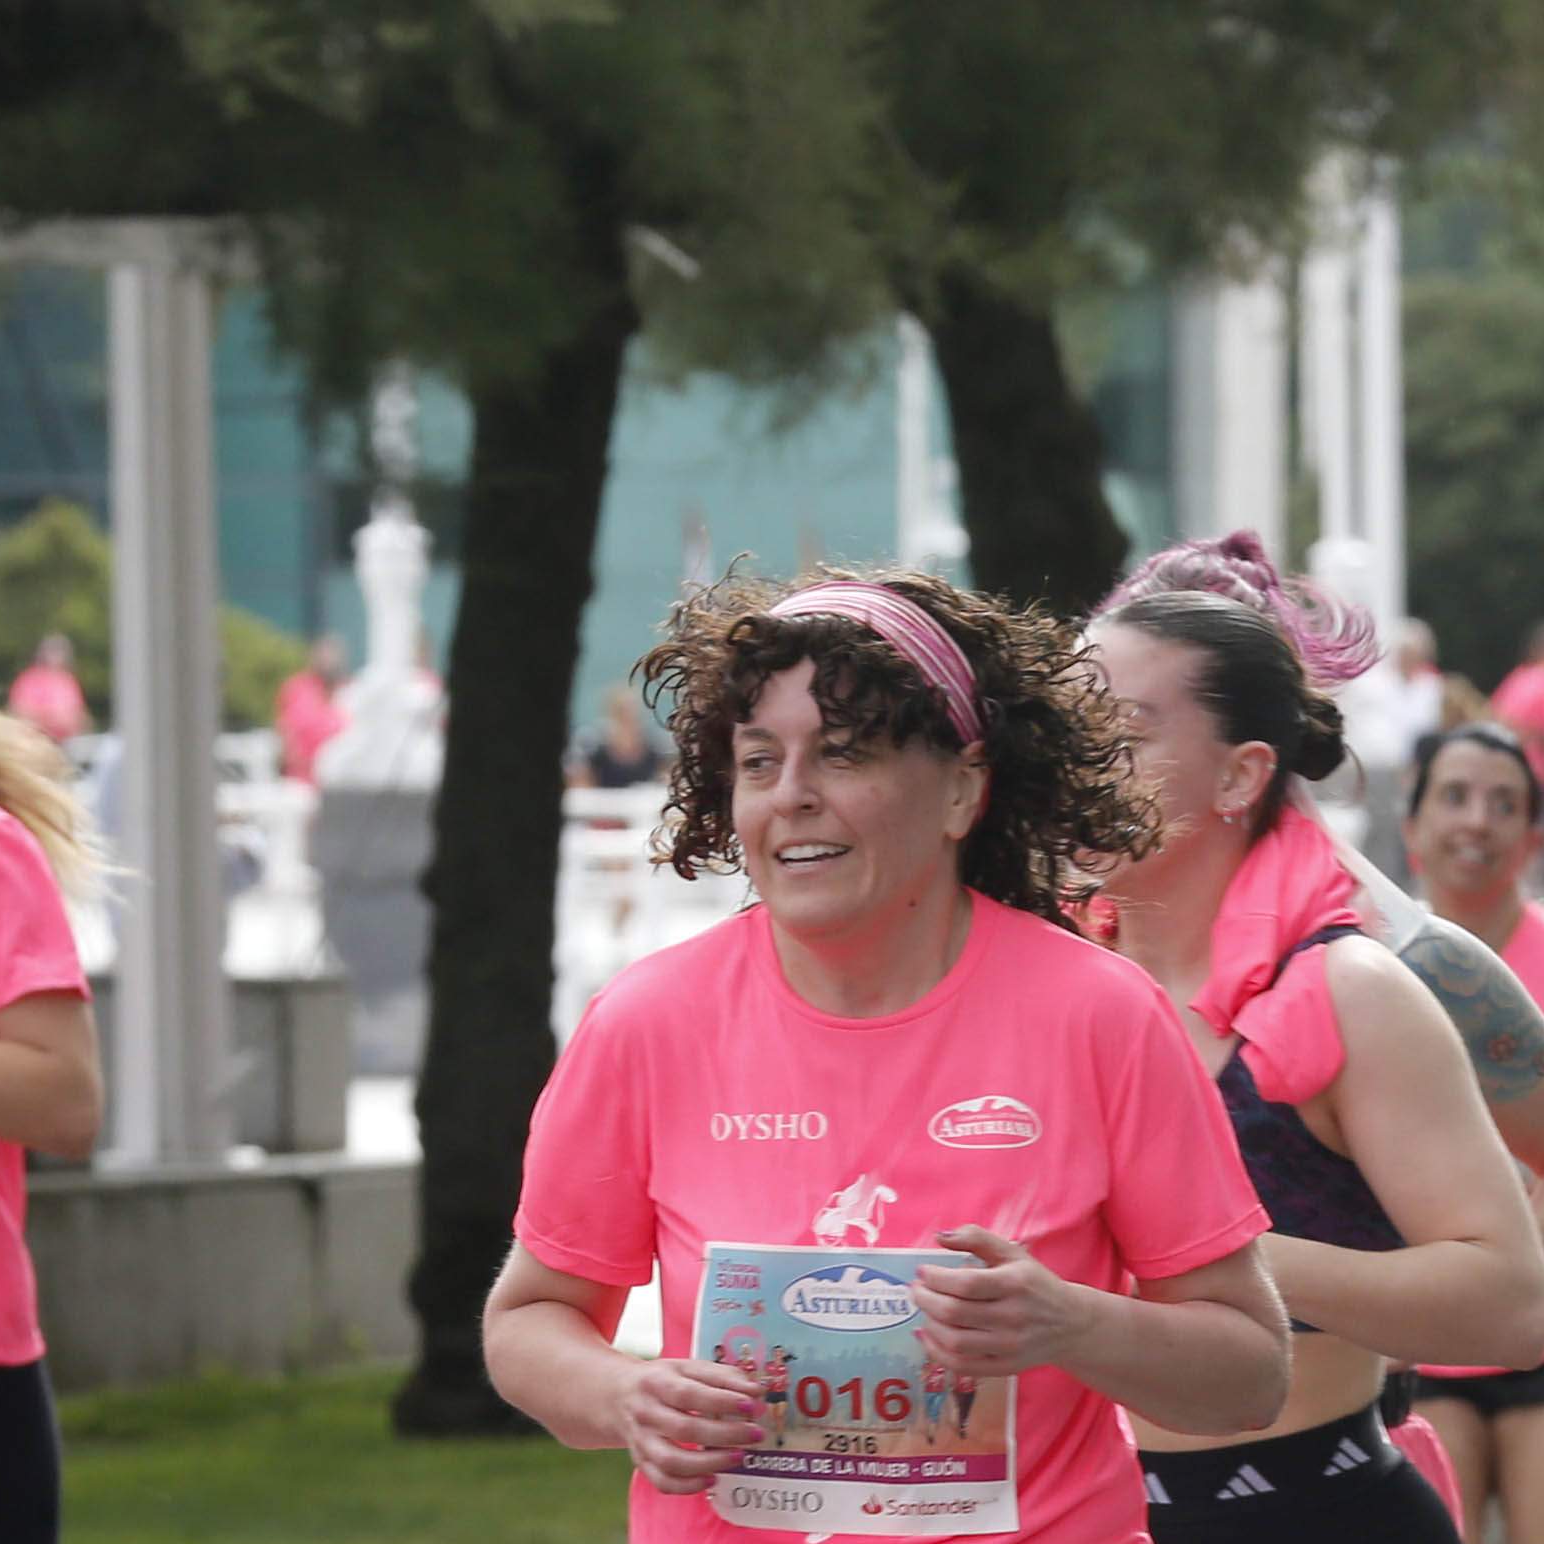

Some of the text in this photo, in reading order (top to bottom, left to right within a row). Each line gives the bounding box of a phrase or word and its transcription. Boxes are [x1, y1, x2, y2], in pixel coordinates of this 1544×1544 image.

[710, 1111, 828, 1142] OYSHO
[937, 1117, 1034, 1138] ASTURIANA
[790, 1287, 911, 1317] ASTURIANA
[794, 1375, 913, 1422] 016
[823, 1433, 879, 1456] 2916
[743, 1454, 808, 1473] CARRERA
[810, 1460, 833, 1475] DE
[836, 1461, 855, 1476] LA
[857, 1461, 911, 1478] MUJER
[731, 1485, 978, 1516] OYSHO Santander
